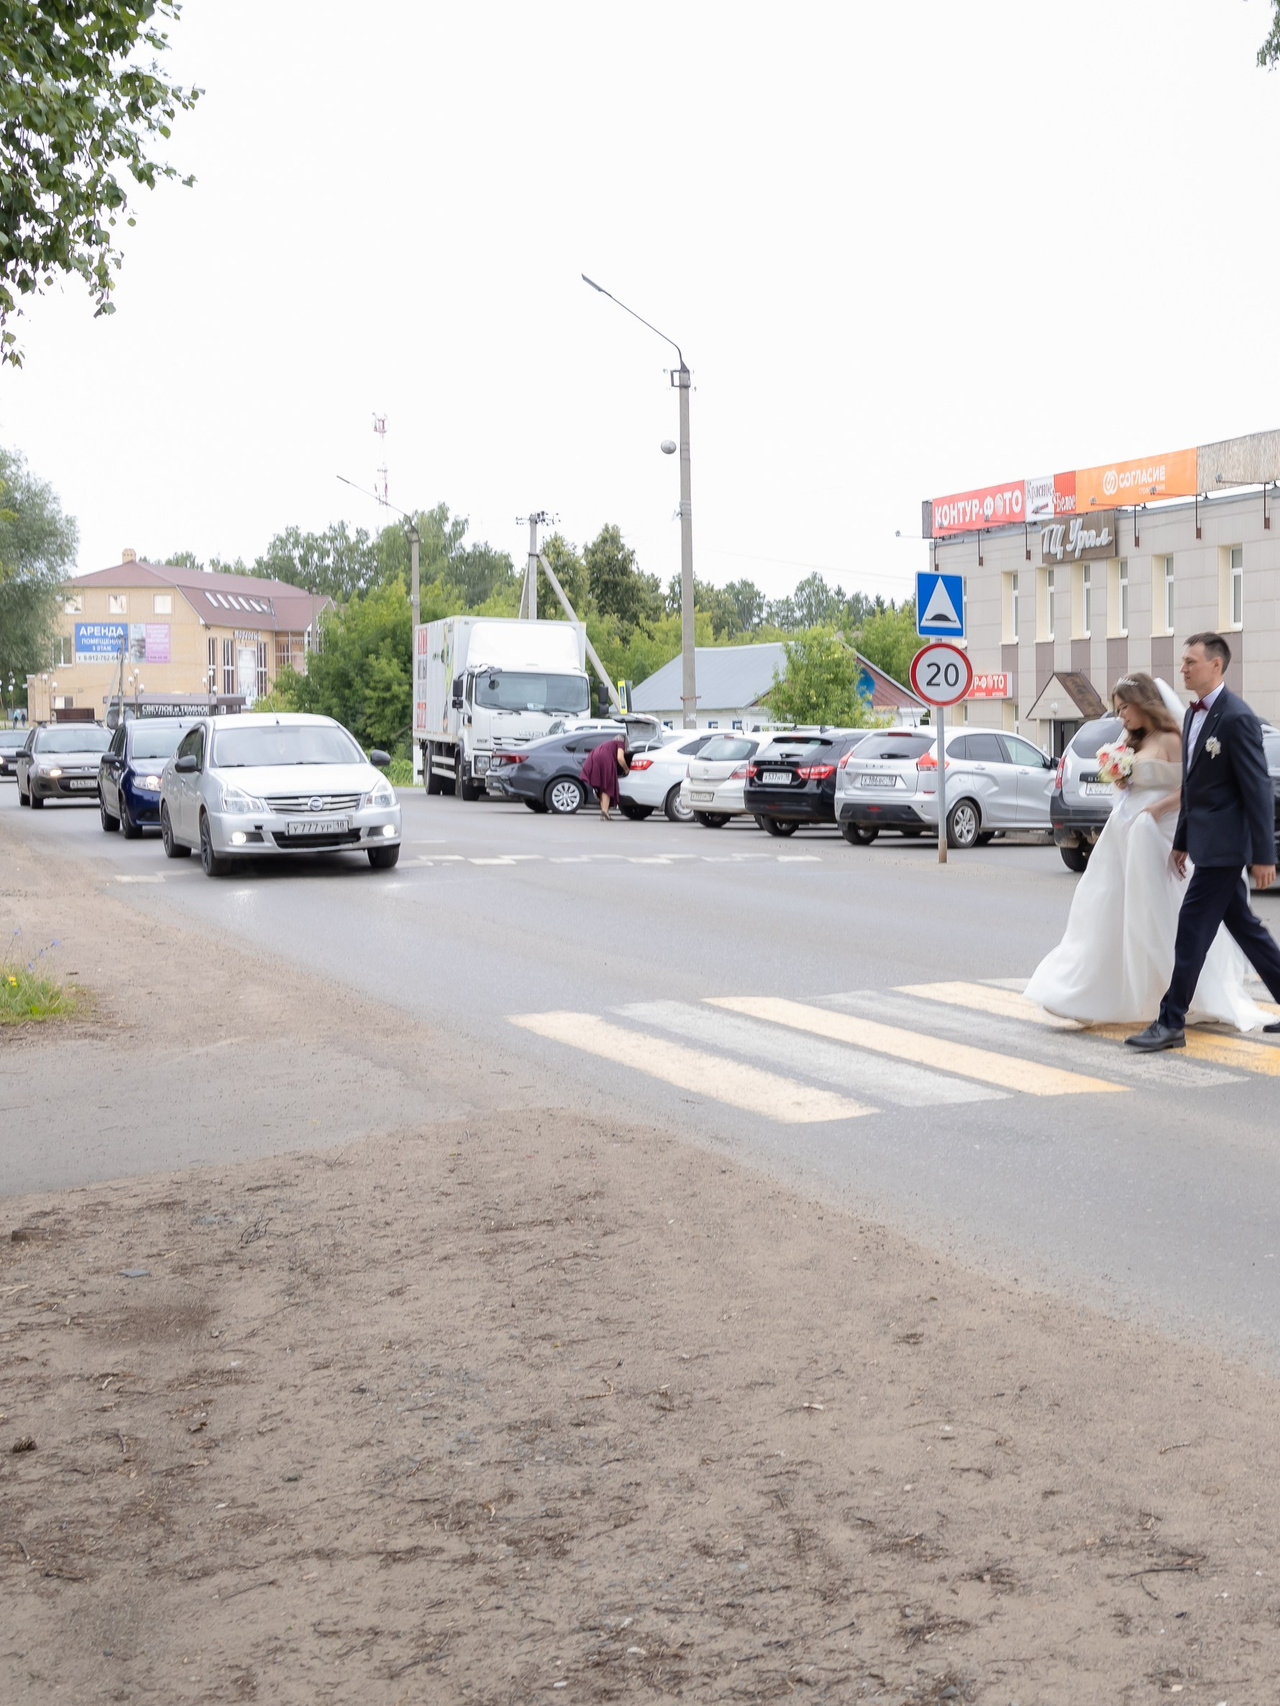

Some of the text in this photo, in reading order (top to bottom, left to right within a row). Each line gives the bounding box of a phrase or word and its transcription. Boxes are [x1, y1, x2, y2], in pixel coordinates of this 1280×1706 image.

[1119, 465, 1166, 488] СОГЛАСИЕ
[1026, 480, 1053, 504] Красное
[1040, 517, 1113, 560] ТЦ Урал
[79, 626, 124, 638] АРЕНДА
[926, 662, 960, 687] 20
[293, 823, 333, 834] У777УР
